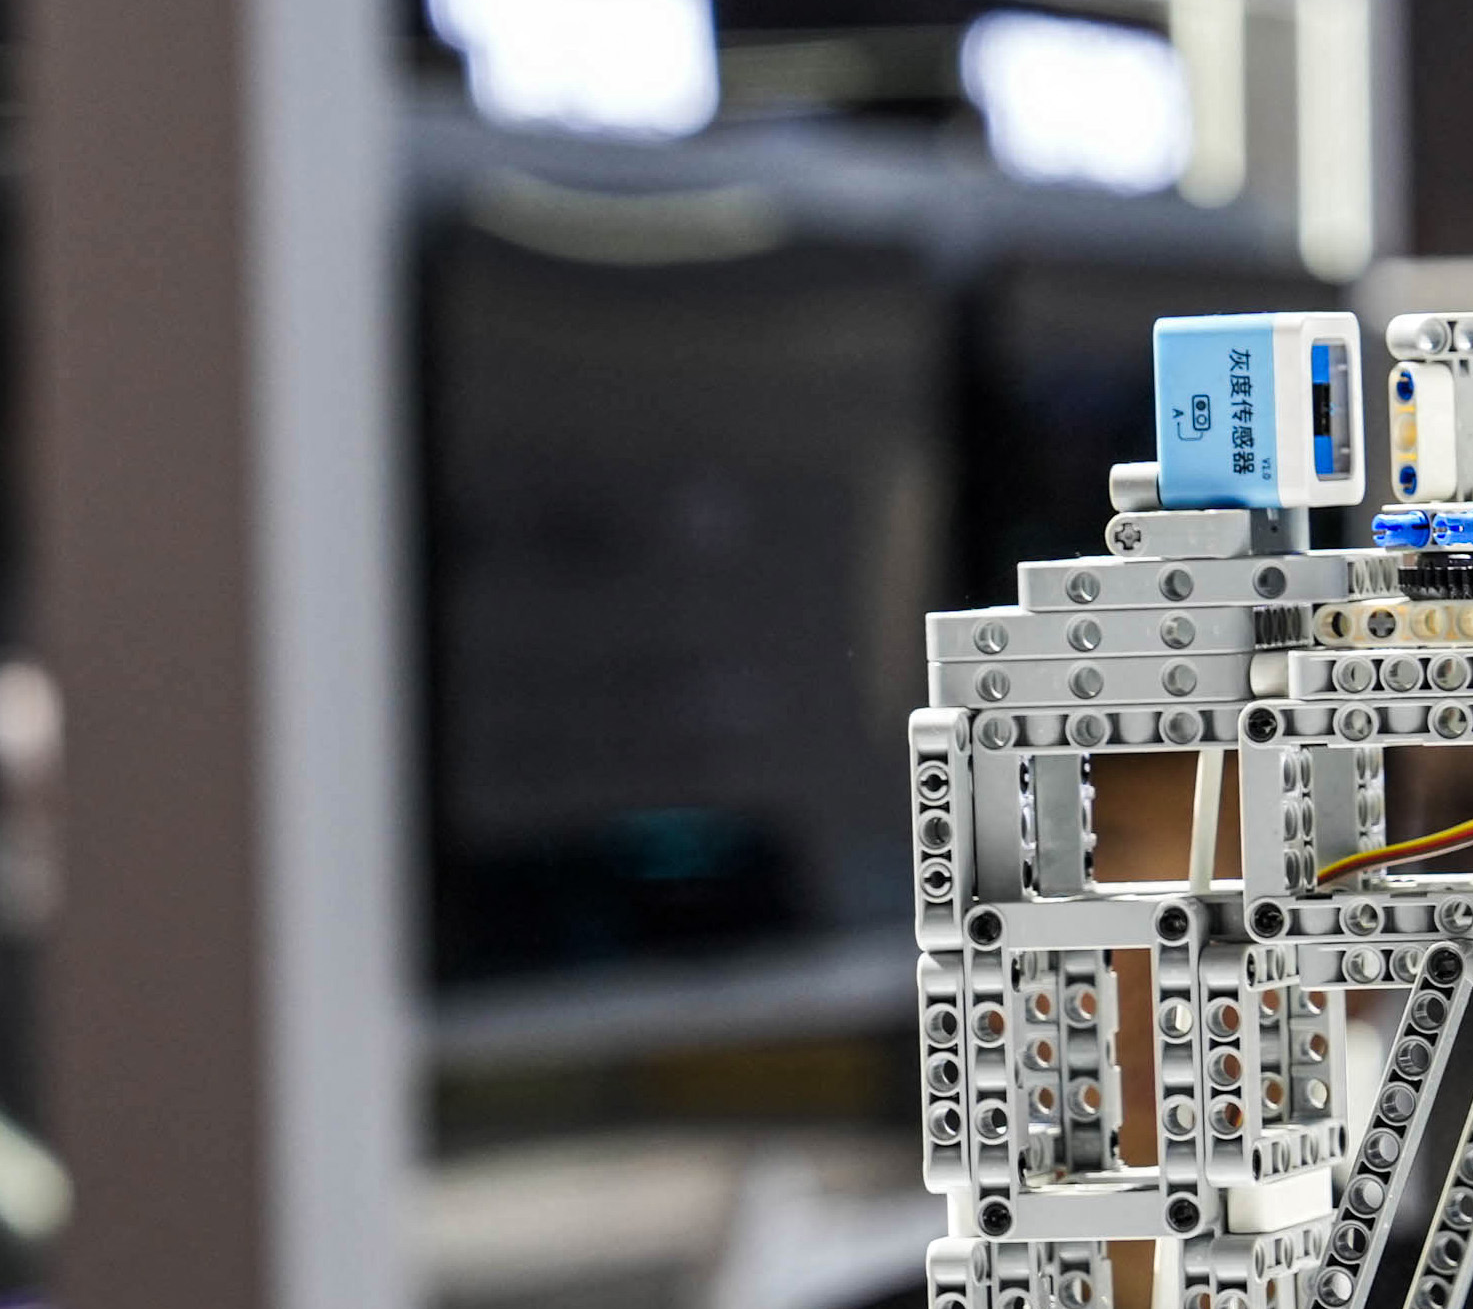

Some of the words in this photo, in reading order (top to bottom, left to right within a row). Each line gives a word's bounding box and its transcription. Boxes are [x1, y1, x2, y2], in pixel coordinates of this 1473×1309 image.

[1172, 408, 1184, 420] A
[1228, 347, 1255, 475] 灰度传感器
